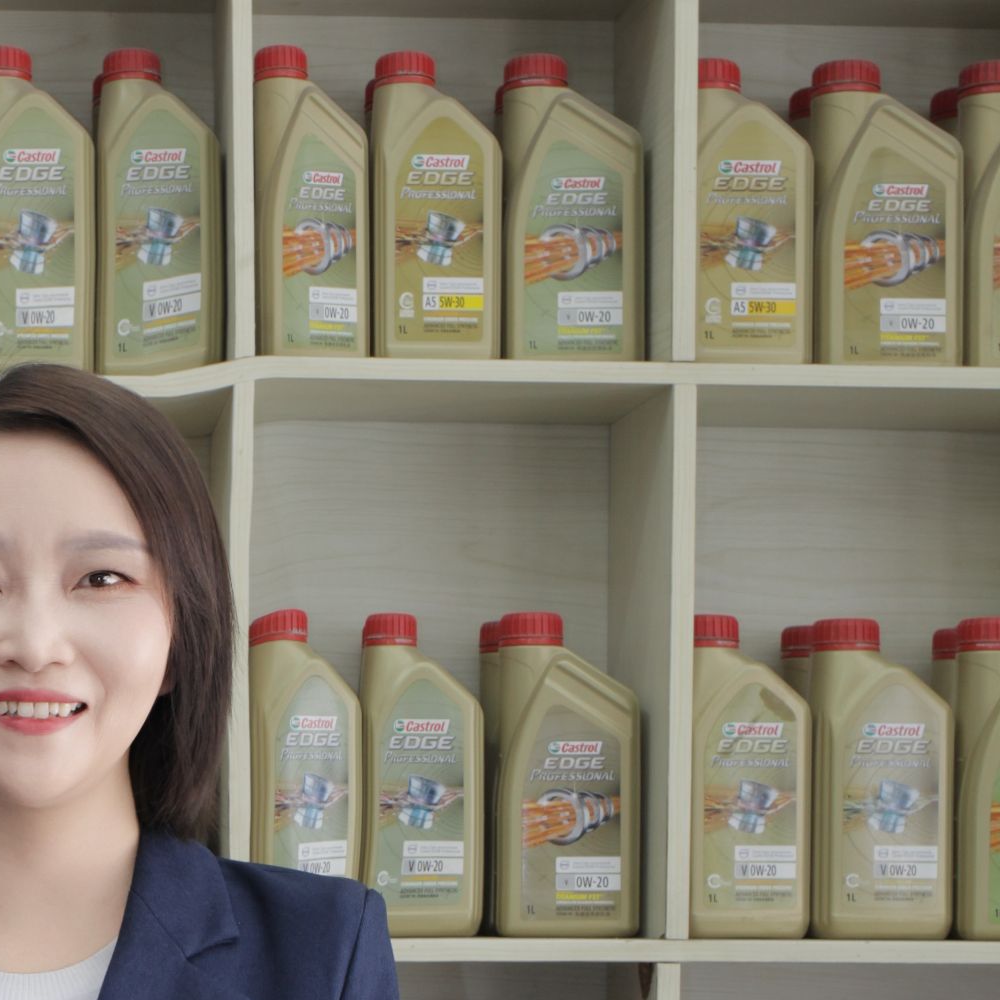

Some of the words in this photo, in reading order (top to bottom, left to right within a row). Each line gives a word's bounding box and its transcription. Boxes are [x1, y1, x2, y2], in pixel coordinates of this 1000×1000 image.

[16, 151, 56, 162] Castrol
[142, 150, 183, 163] Castrol
[424, 156, 465, 169] Castrol
[0, 166, 64, 181] EDGE
[126, 166, 189, 180] EDGE
[733, 162, 777, 173] Castrol
[312, 173, 340, 184] Castrol
[406, 172, 473, 185] EDGE
[564, 179, 601, 189] Castrol
[712, 177, 787, 191] EDGE
[299, 187, 345, 200] EDGE
[886, 185, 925, 196] Castrol
[546, 193, 607, 205] EDGE
[868, 201, 931, 212] EDGE
[157, 299, 182, 315] 0W-20
[439, 296, 464, 308] 5W-30
[748, 302, 777, 313] 5W-30
[31, 311, 55, 323] 0W-20
[324, 307, 349, 319] 0W-20
[579, 311, 611, 322] 0W-20
[901, 318, 934, 329] 0W-20
[301, 717, 333, 729] Castrol
[404, 721, 445, 732] Castrol
[736, 724, 779, 736] Castrol
[878, 724, 921, 737] Castrol
[285, 733, 340, 746] EDGE
[389, 736, 455, 749] EDGE
[560, 742, 598, 753] Castrol
[718, 740, 788, 753] EDGE
[856, 741, 930, 754] EDGE
[543, 757, 604, 769] EDGE
[418, 860, 443, 872] 0W-20
[751, 865, 777, 877] 0W-20
[890, 865, 917, 877] 0W-20
[576, 876, 609, 888] 0W-20
